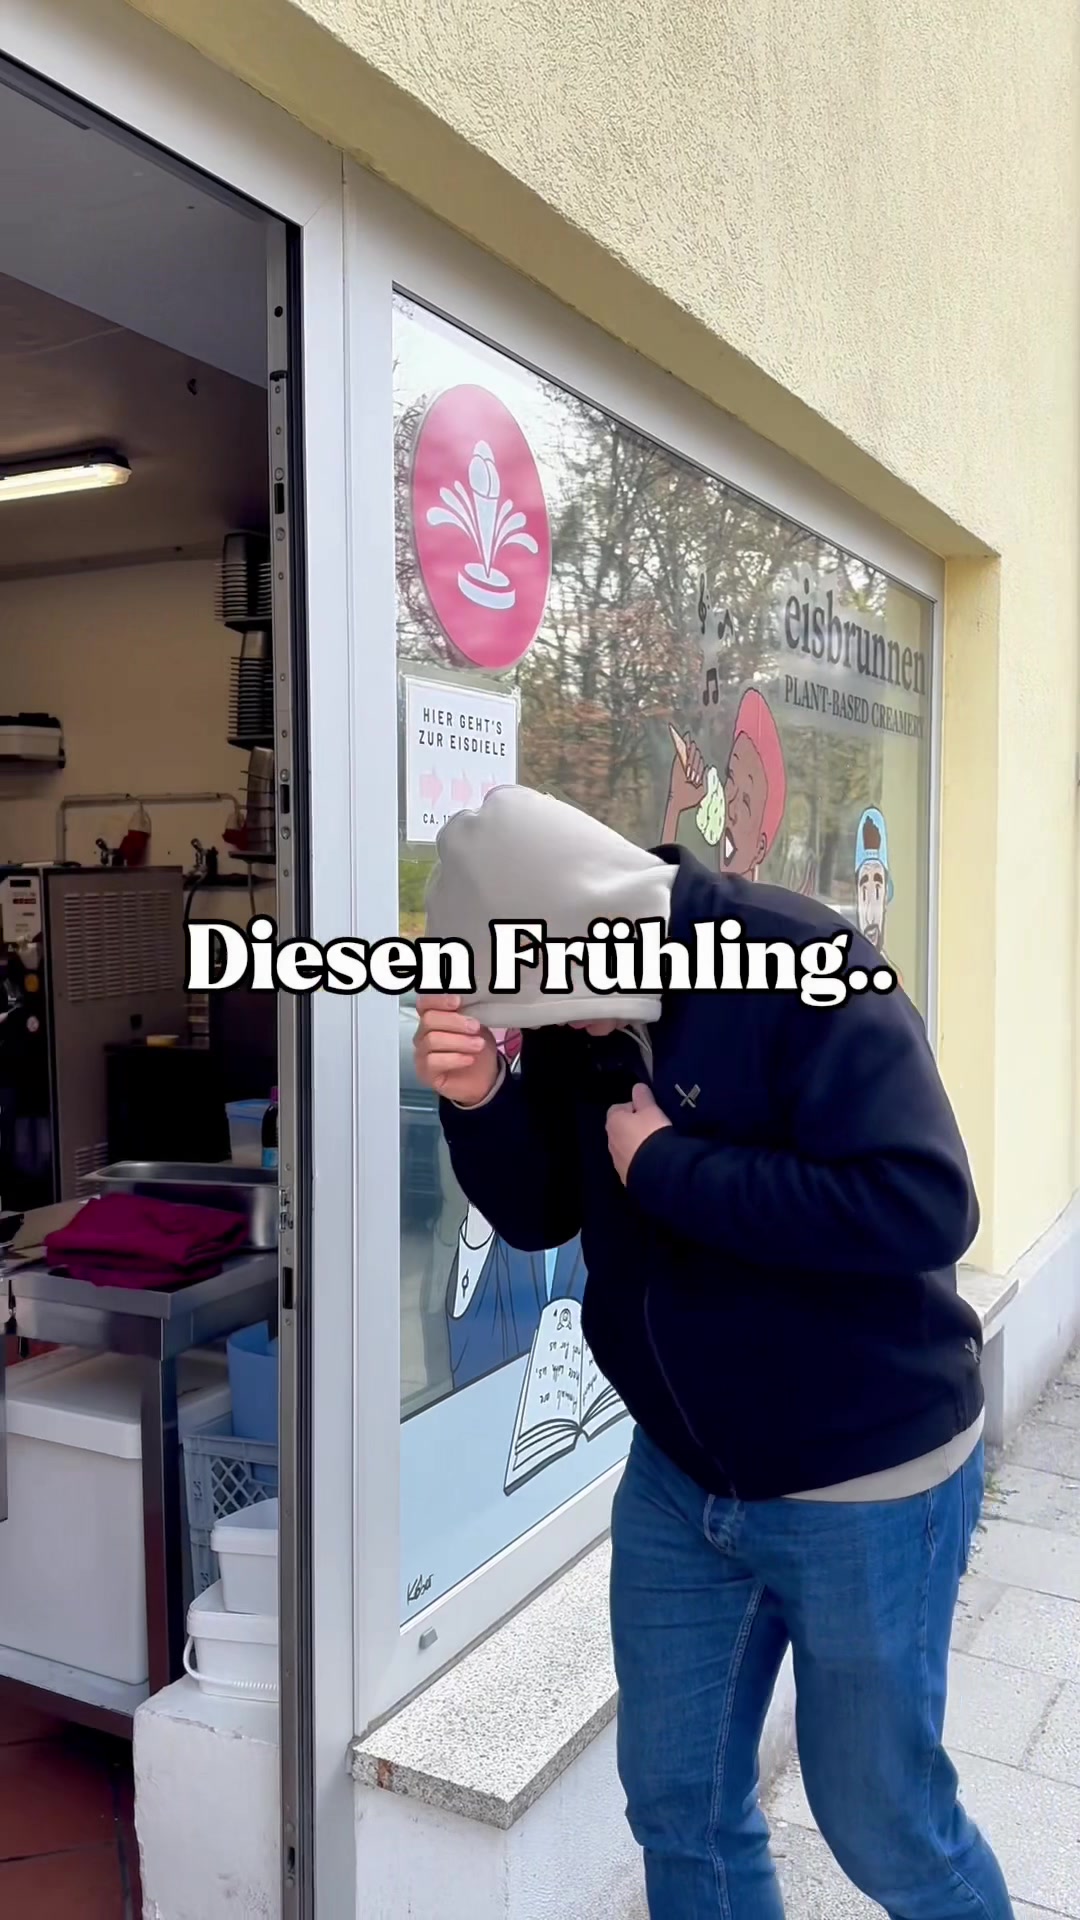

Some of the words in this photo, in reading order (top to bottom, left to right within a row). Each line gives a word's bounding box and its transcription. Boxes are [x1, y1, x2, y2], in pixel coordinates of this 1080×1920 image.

[785, 578, 925, 696] eisbrunnen
[785, 674, 869, 725] PLANT-BASED
[423, 707, 453, 726] HIER
[459, 714, 502, 735] GEHT'S
[418, 730, 443, 747] ZUR
[450, 735, 506, 757] EISDIELE
[423, 813, 439, 824] CA.
